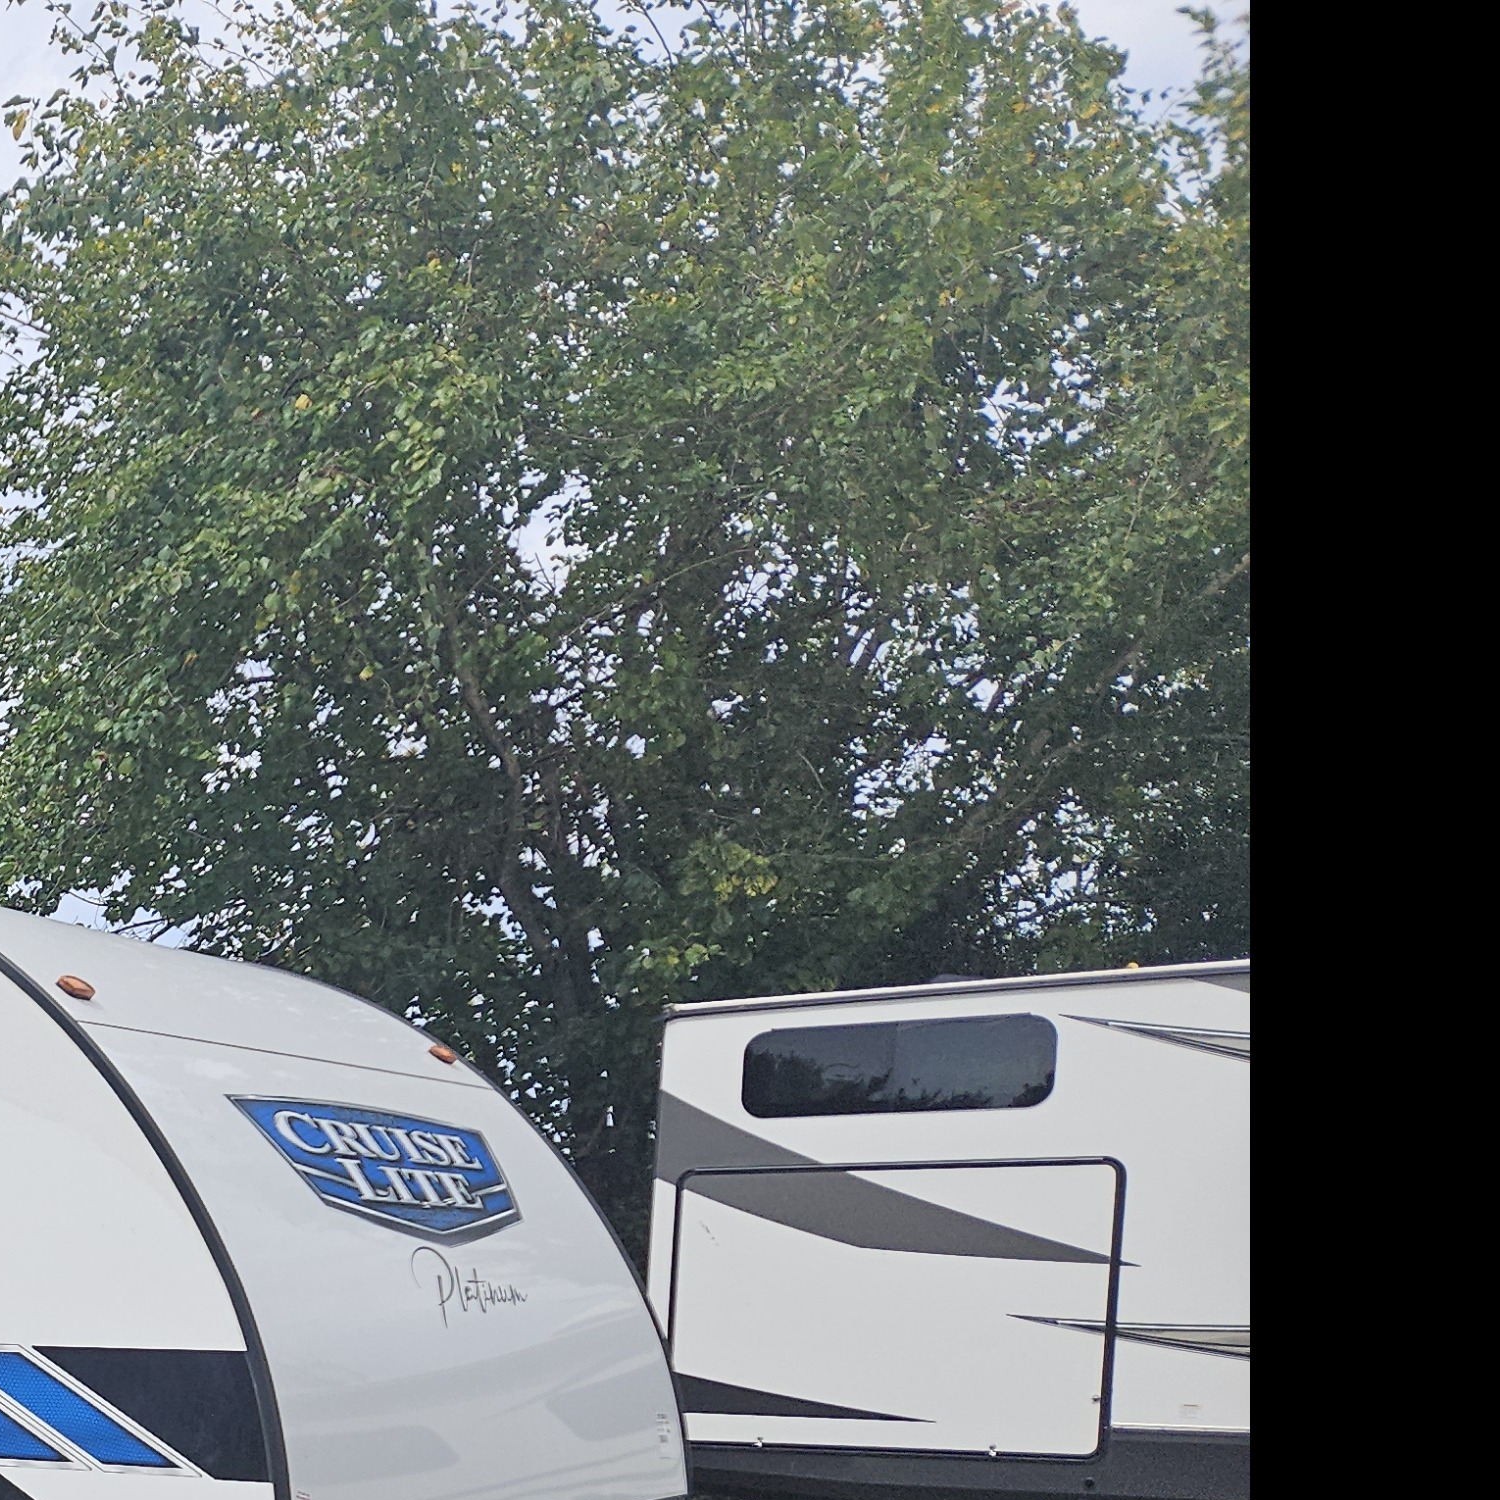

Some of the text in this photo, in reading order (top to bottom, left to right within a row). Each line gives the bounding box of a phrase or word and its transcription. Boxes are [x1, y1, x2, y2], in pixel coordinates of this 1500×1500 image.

[273, 1110, 483, 1170] CRUISE
[336, 1157, 485, 1210] LITE
[411, 1246, 528, 1329] Platinum
